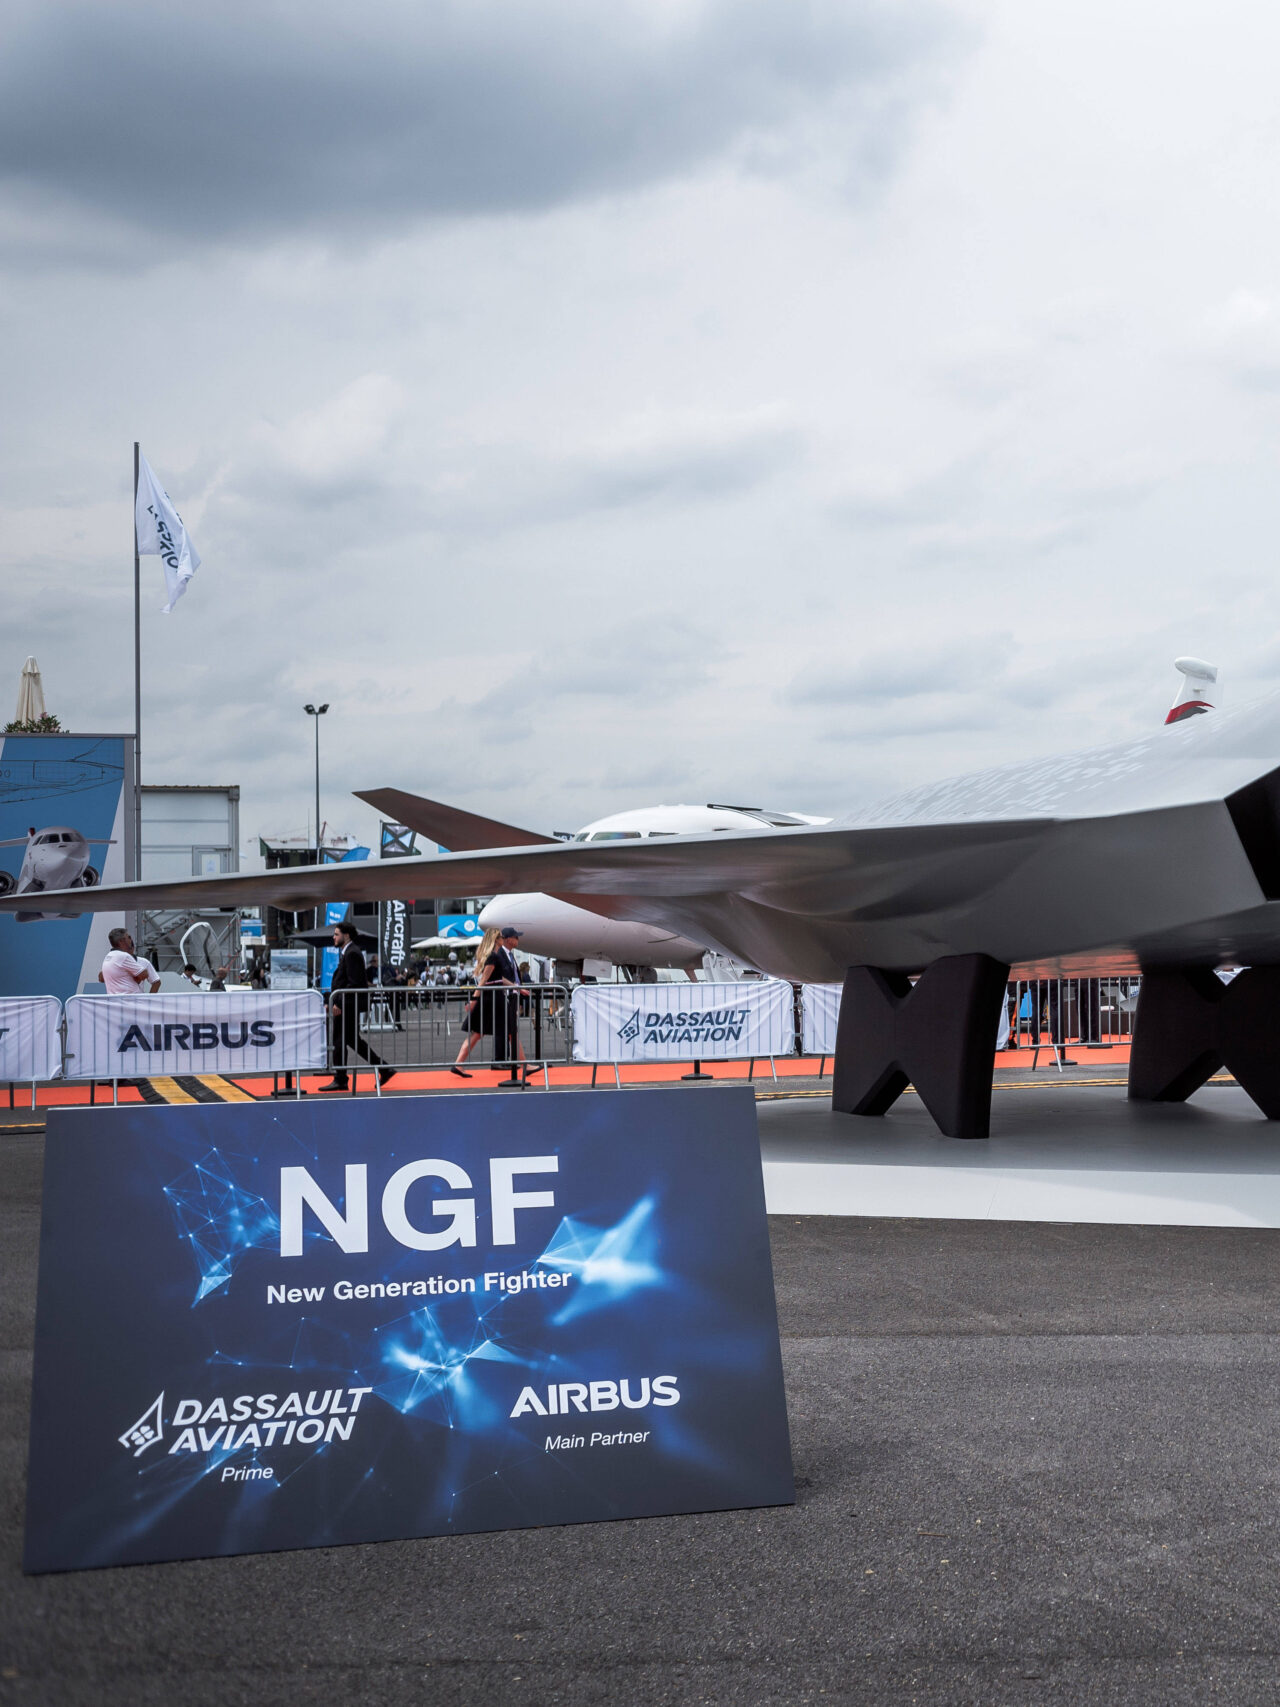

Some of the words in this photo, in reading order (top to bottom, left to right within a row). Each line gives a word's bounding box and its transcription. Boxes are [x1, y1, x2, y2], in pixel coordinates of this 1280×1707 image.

[391, 900, 406, 966] Aircraft
[643, 1026, 742, 1044] AVIATION
[645, 1009, 751, 1028] DASSAULT
[117, 1020, 276, 1053] AIRBUS
[280, 1155, 559, 1257] NGF
[266, 1285, 325, 1304] New
[333, 1275, 476, 1300] Generation
[484, 1270, 572, 1294] Fighter
[172, 1387, 373, 1426] DASSAULT
[509, 1375, 681, 1418] AIRBUS
[168, 1416, 356, 1454] AVIATION
[545, 1434, 585, 1450] Main
[590, 1430, 650, 1446] Partner
[221, 1467, 274, 1482] Prime
